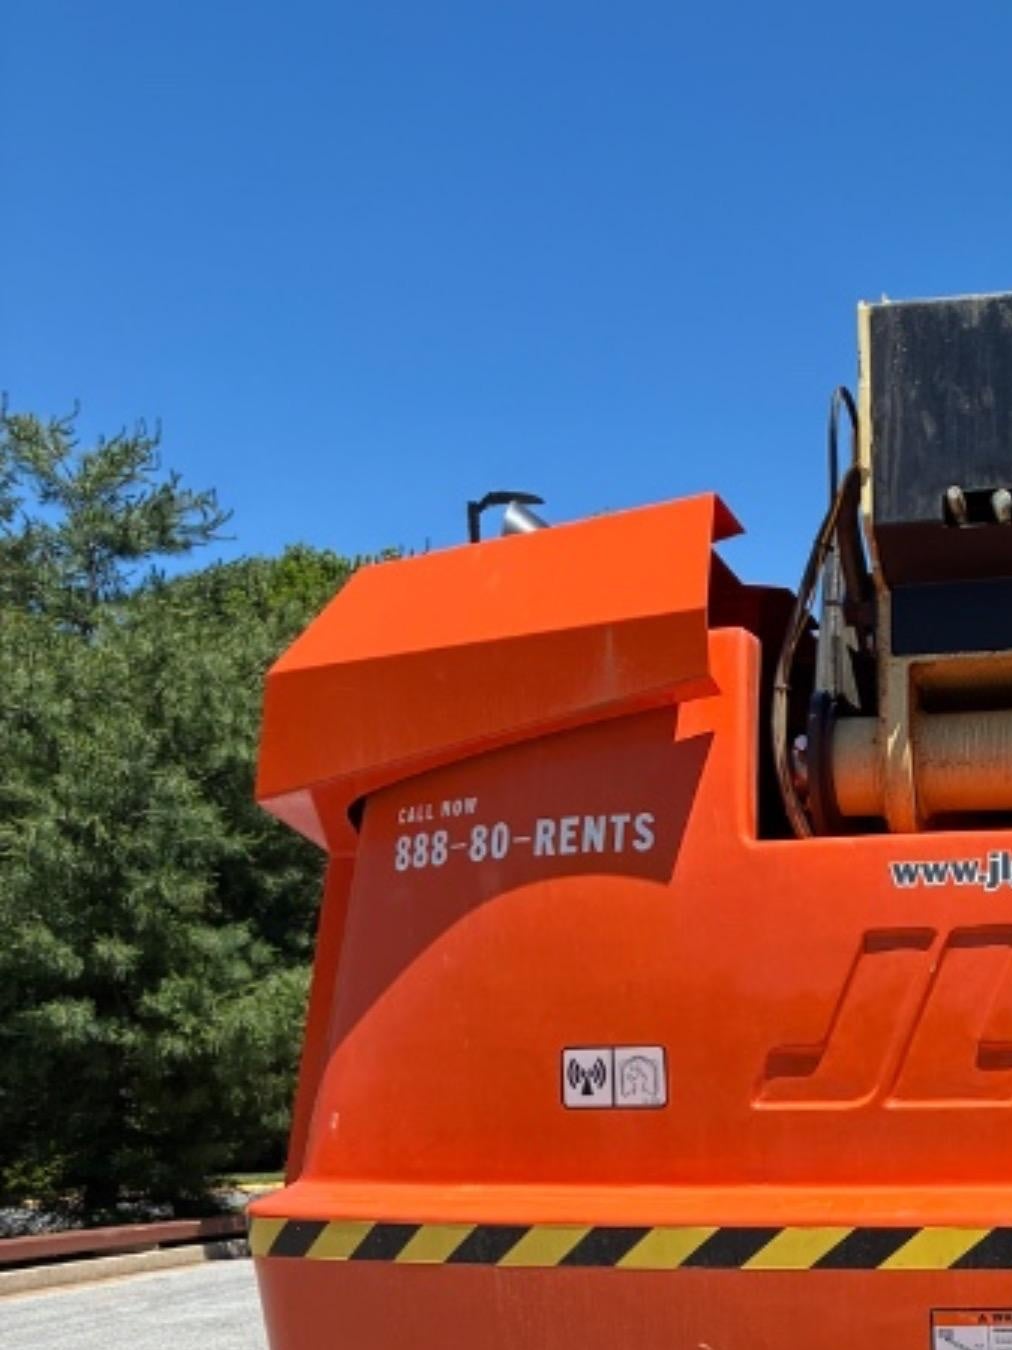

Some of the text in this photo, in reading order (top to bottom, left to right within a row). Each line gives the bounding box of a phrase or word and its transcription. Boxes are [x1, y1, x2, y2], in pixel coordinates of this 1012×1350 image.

[398, 797, 478, 825] CALL NOW
[395, 812, 655, 872] 888-80-RENTS
